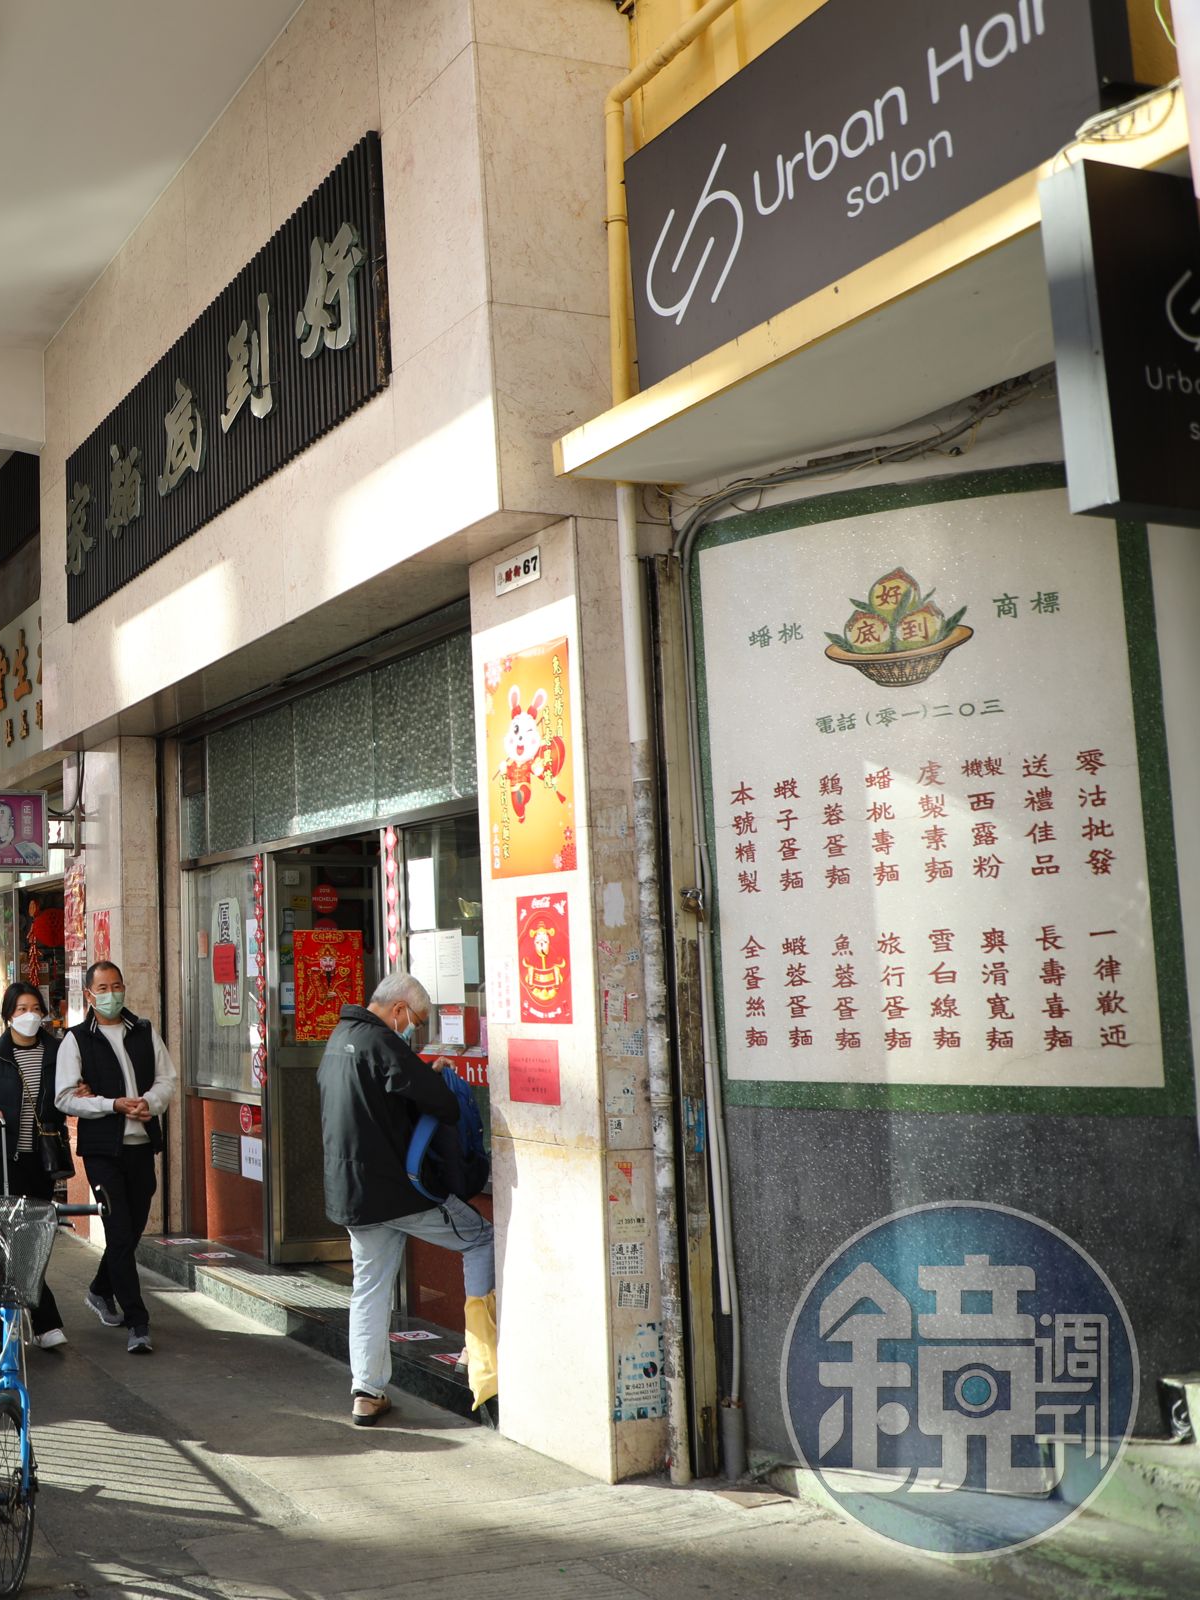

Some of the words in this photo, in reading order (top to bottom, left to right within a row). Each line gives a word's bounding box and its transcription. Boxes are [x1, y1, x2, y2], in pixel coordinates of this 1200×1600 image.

[754, 86, 908, 216] Urban
[846, 130, 953, 218] salon
[523, 555, 538, 575] 67
[875, 585, 902, 606] 好
[992, 591, 1061, 618] 商標
[748, 622, 804, 648] 蟠桃
[853, 621, 881, 644] 底
[902, 620, 928, 641] 到
[730, 781, 761, 893] 本號精製
[865, 767, 900, 886] 蟠桃壽麵
[1021, 754, 1060, 877] 送禮佳品
[1076, 749, 1117, 877] 零沽批發
[928, 928, 961, 1051] 雪白線麵
[1036, 925, 1072, 1051] 長壽喜麵
